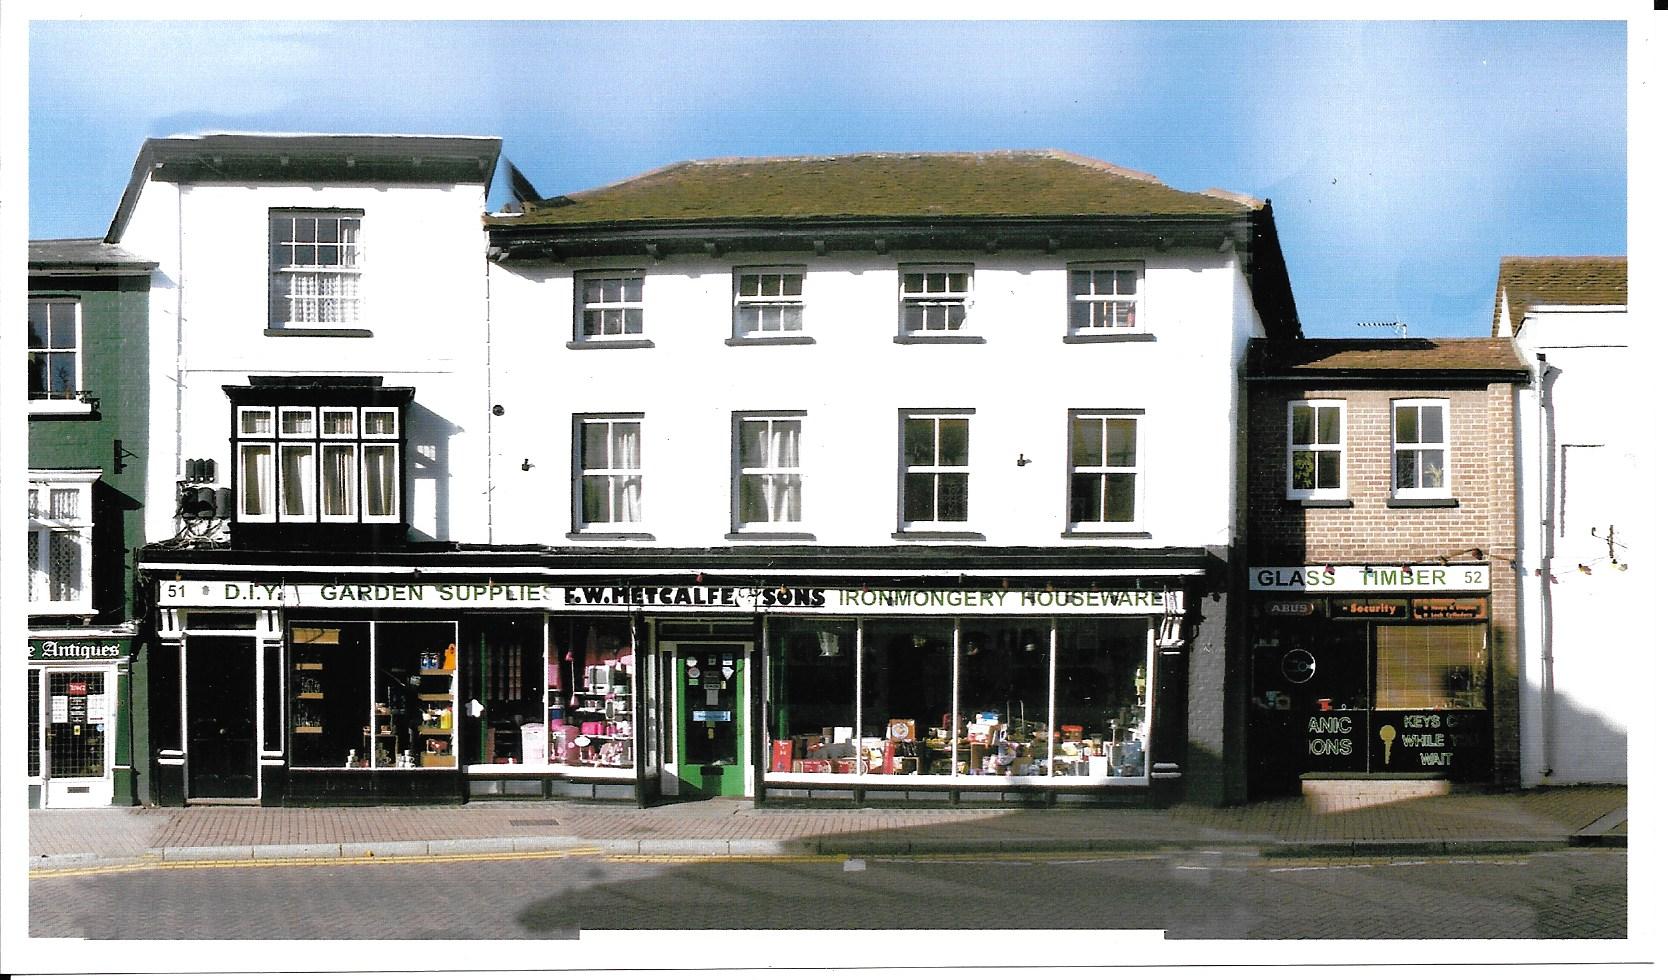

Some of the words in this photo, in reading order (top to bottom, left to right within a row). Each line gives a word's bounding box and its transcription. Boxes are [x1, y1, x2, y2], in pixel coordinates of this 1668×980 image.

[1257, 570, 1336, 587] GLASS
[1359, 570, 1447, 587] TIMBER
[1464, 571, 1482, 584] 52
[168, 585, 185, 598] 51
[320, 584, 423, 601] GARDEN
[762, 587, 826, 605] SONS
[839, 590, 1008, 607] IRONMONGERY
[1271, 603, 1308, 613] ABUS
[1350, 603, 1397, 615] Security
[42, 641, 120, 659] Antiques
[1404, 715, 1441, 728] KEYS
[1402, 734, 1445, 747] WHILE
[1420, 752, 1453, 766] WAIT
